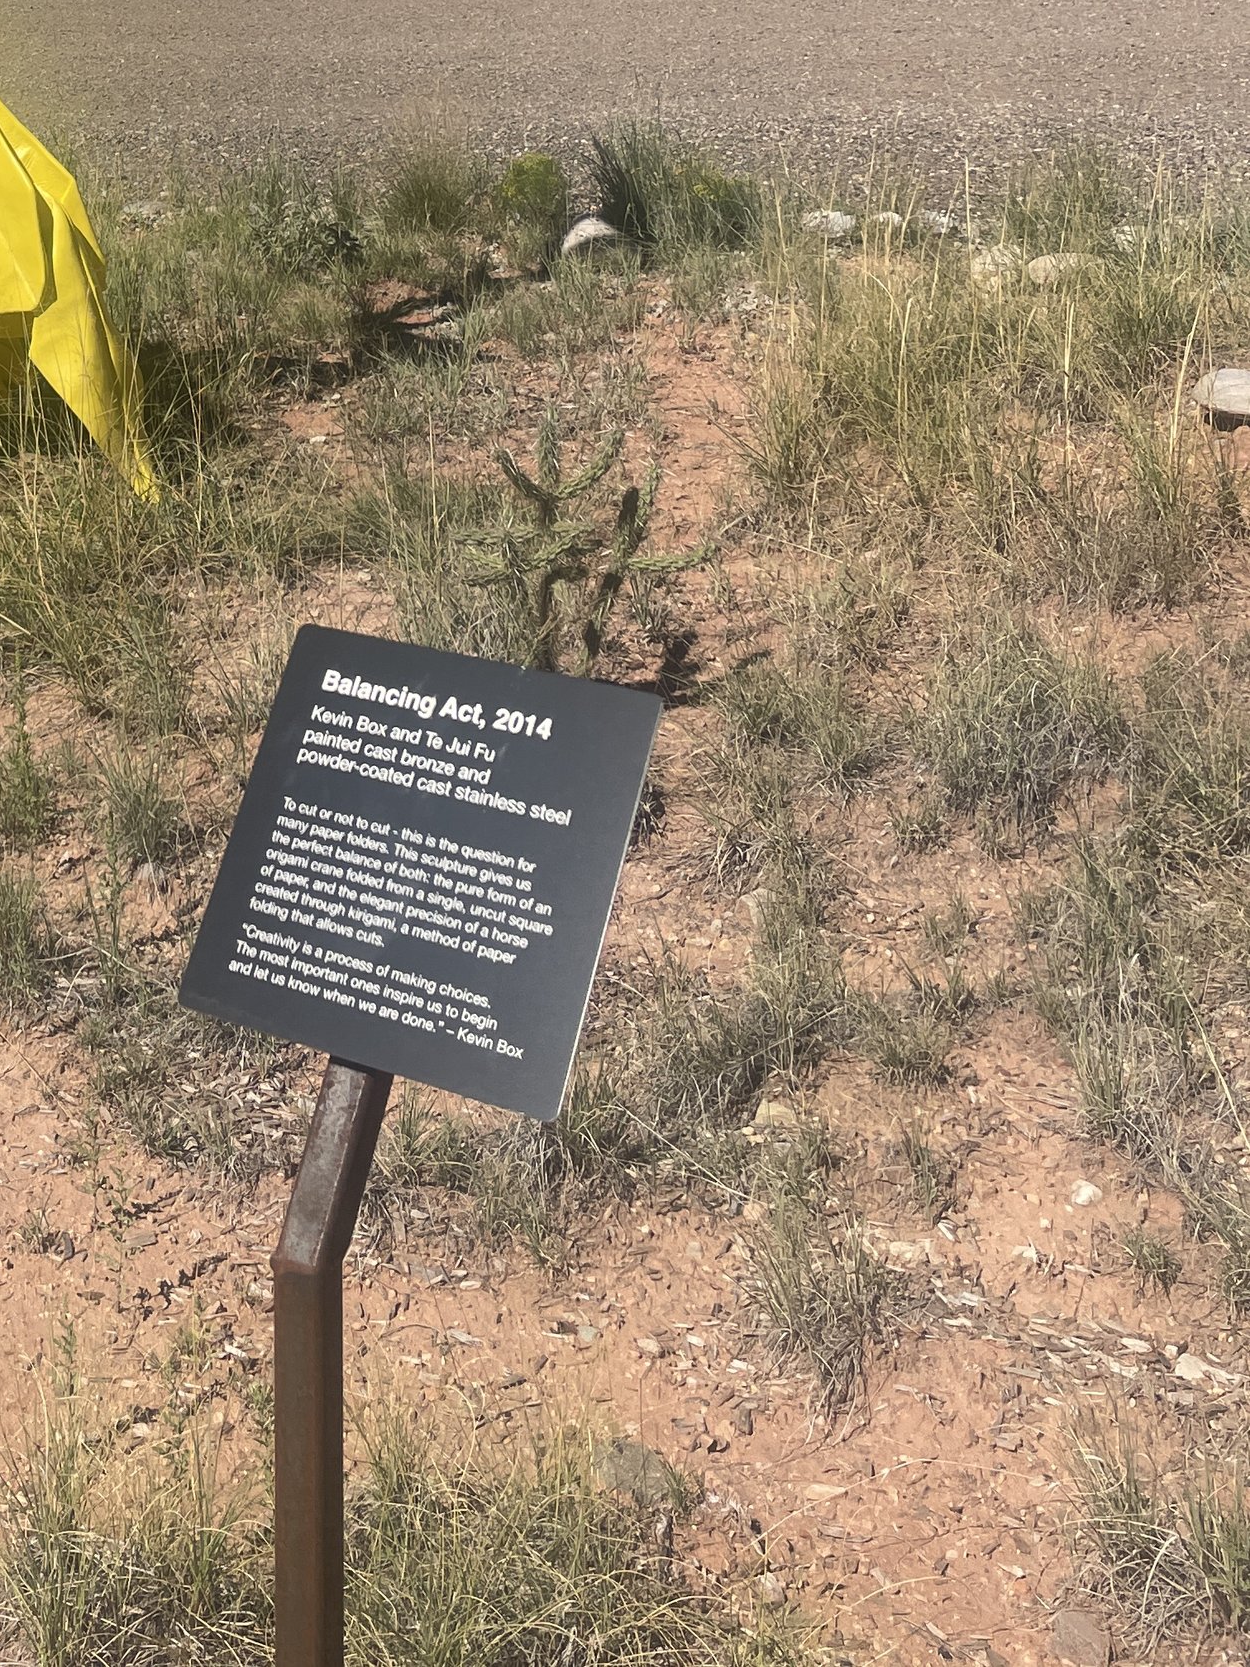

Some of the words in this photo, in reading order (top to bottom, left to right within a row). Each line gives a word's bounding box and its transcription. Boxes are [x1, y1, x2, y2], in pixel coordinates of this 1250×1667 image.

[310, 704, 354, 730] Kevin
[355, 715, 389, 738] Box
[389, 726, 423, 746] and
[425, 730, 444, 750] Te
[445, 736, 472, 757] Jui
[473, 742, 496, 763] Fu
[321, 668, 437, 720] Balancing
[438, 696, 487, 731] Act,
[491, 707, 553, 741] 2014
[296, 748, 416, 788] powder-coated
[416, 776, 453, 798] cast
[453, 785, 527, 816] stainless
[528, 803, 573, 827] steel
[302, 729, 363, 754] painted
[363, 743, 399, 764] cast
[399, 748, 456, 777] bronze
[457, 765, 492, 785] and
[271, 829, 291, 846] the
[290, 837, 334, 858] perfect
[334, 845, 382, 871] balance
[383, 861, 399, 875] of
[398, 862, 431, 884] both:
[433, 872, 454, 891] the
[454, 880, 485, 899] pure
[486, 886, 517, 908] form
[518, 897, 535, 912] of
[534, 902, 553, 917] an
[276, 815, 310, 835] many
[309, 824, 346, 842] paper
[346, 830, 390, 855] folders.
[394, 842, 419, 862] This
[419, 853, 478, 878] sculpture
[478, 867, 514, 888] gives
[515, 878, 533, 893] us
[283, 796, 297, 812] To
[298, 803, 318, 818] cut
[318, 808, 334, 821] or
[333, 812, 355, 827] not
[355, 815, 369, 831] to
[370, 821, 391, 837] cut
[400, 827, 424, 845] this
[424, 832, 437, 849] is
[438, 837, 460, 854] the
[460, 845, 516, 869] question
[516, 856, 538, 874] for
[249, 896, 289, 922] folding
[290, 908, 315, 927] that
[315, 916, 355, 939] allows
[355, 929, 385, 948] cuts.
[254, 881, 300, 904] created
[300, 892, 346, 917] through
[347, 905, 398, 934] kirigami,
[399, 923, 410, 935] a
[411, 925, 461, 949] method
[461, 939, 478, 954] of
[476, 944, 518, 965] paper
[260, 864, 275, 878] of
[273, 868, 310, 890] paper,
[312, 879, 337, 896] and
[337, 884, 358, 902] the
[359, 891, 405, 915] elegant
[404, 905, 463, 931] precision
[464, 921, 481, 935] of
[479, 926, 490, 939] a
[490, 926, 529, 950] horse
[265, 848, 310, 869] origami
[310, 860, 345, 879] crane
[345, 867, 385, 890] folded
[385, 878, 415, 899] from
[415, 889, 425, 902] a
[426, 890, 466, 915] single,
[469, 903, 507, 924] uncut
[507, 914, 554, 937] square
[228, 959, 254, 976] and
[253, 964, 270, 982] let
[270, 972, 286, 987] us
[287, 974, 322, 997] know
[322, 987, 356, 1008] when
[358, 998, 377, 1015] we
[378, 1005, 400, 1021] are
[456, 1026, 494, 1051] Kevin
[494, 1038, 525, 1060] Box
[236, 938, 258, 959] The
[258, 949, 290, 969] most
[290, 956, 349, 986] important
[349, 977, 381, 996] ones
[382, 983, 425, 1009] inspire
[426, 1000, 443, 1015] us
[445, 1003, 459, 1019] to
[460, 1007, 498, 1031] begin
[301, 940, 313, 956] is
[314, 946, 324, 960] a
[323, 950, 374, 974] process
[375, 964, 391, 978] of
[390, 969, 437, 995] making
[438, 982, 492, 1010] choices.
